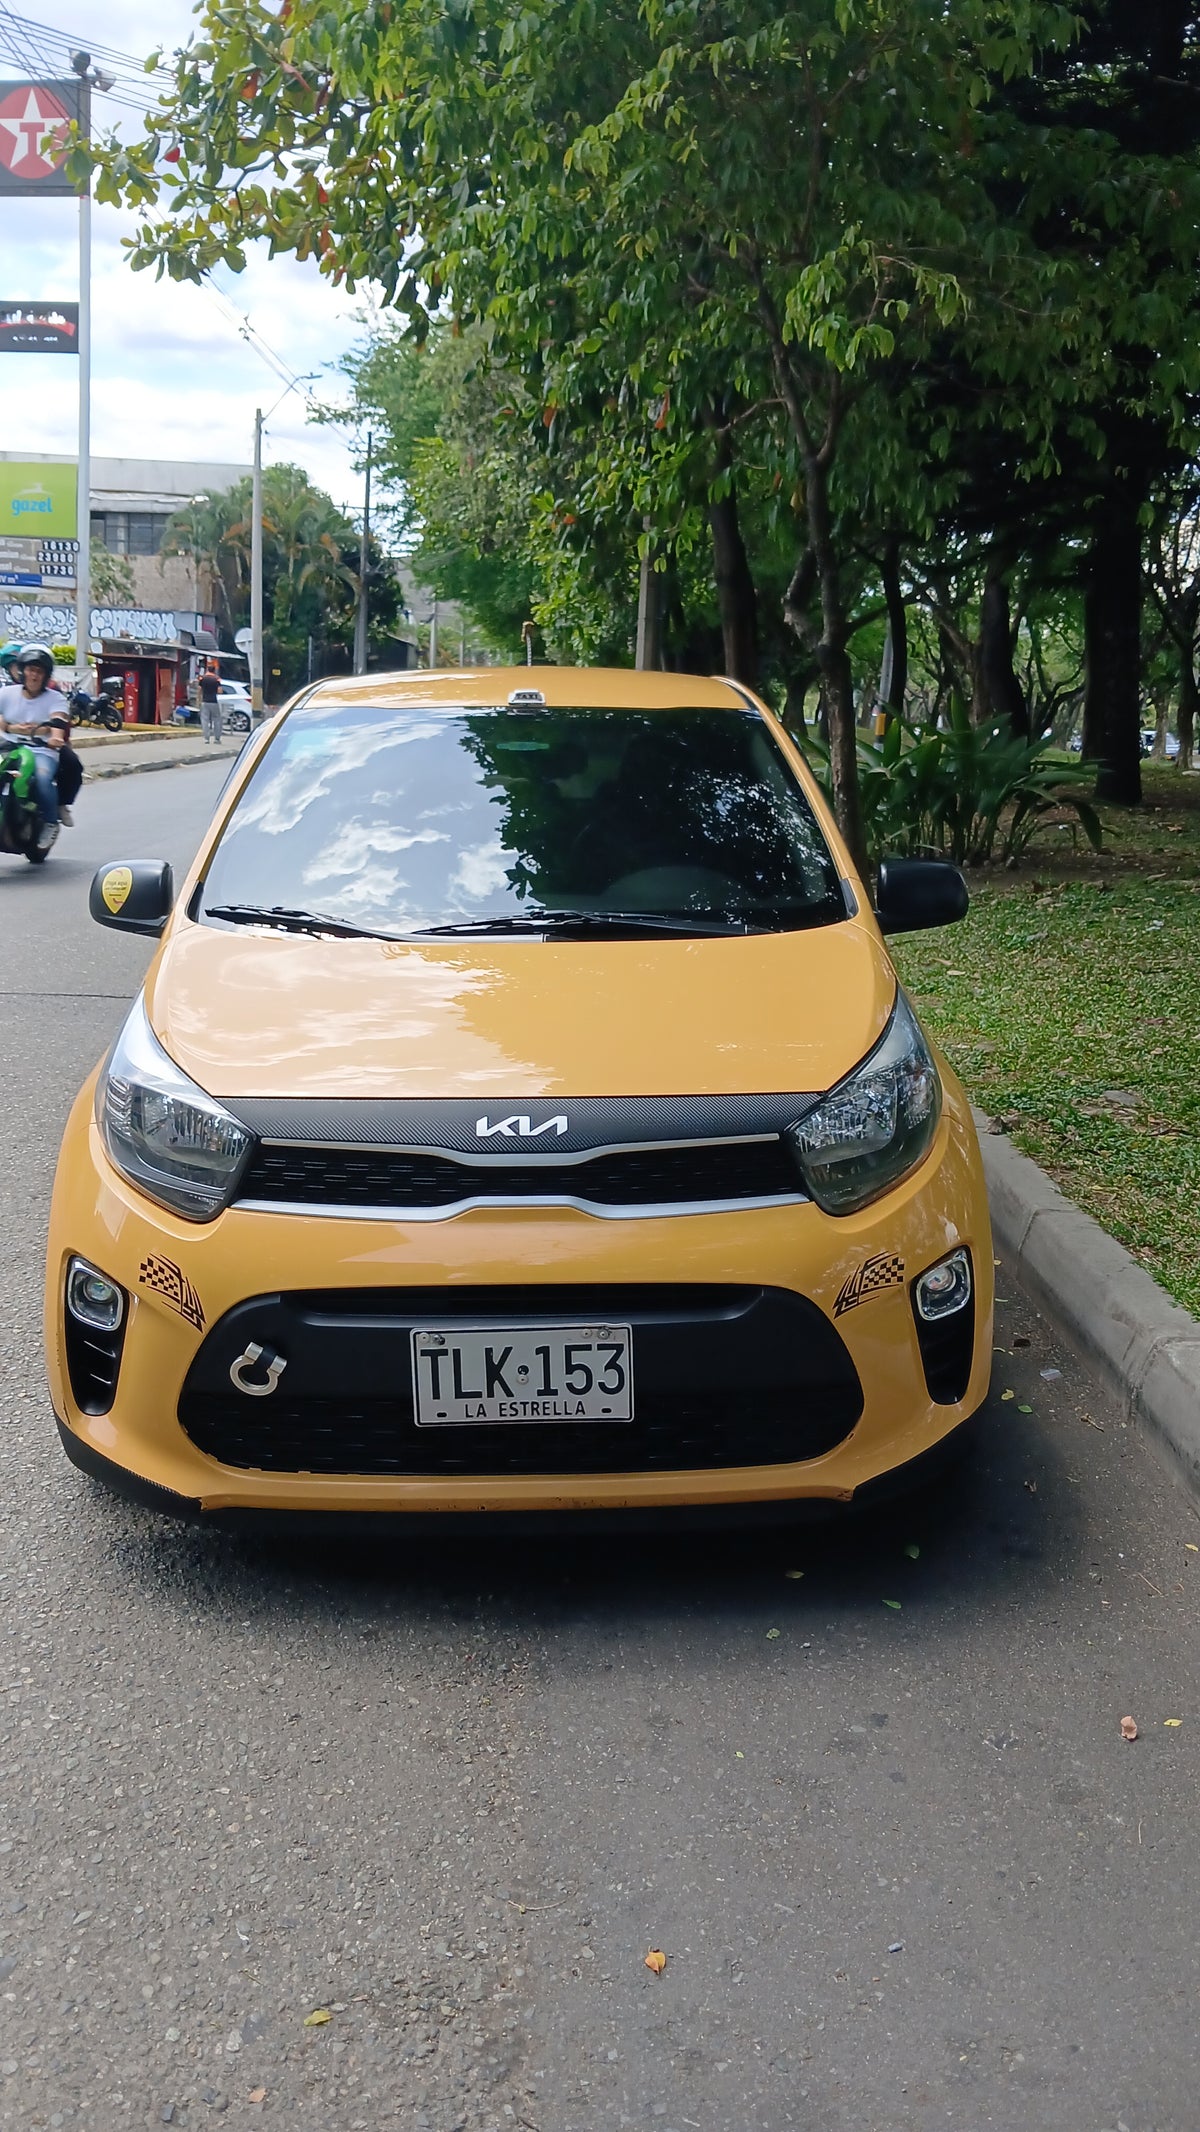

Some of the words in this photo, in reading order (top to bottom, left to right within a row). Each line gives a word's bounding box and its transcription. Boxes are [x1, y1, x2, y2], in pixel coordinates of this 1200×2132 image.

[11, 496, 53, 517] gazel
[40, 565, 74, 576] 11730
[475, 1115, 569, 1137] KIA
[535, 1344, 625, 1396] 153
[465, 1403, 487, 1418] LA
[500, 1400, 586, 1417] ESTRELLA
